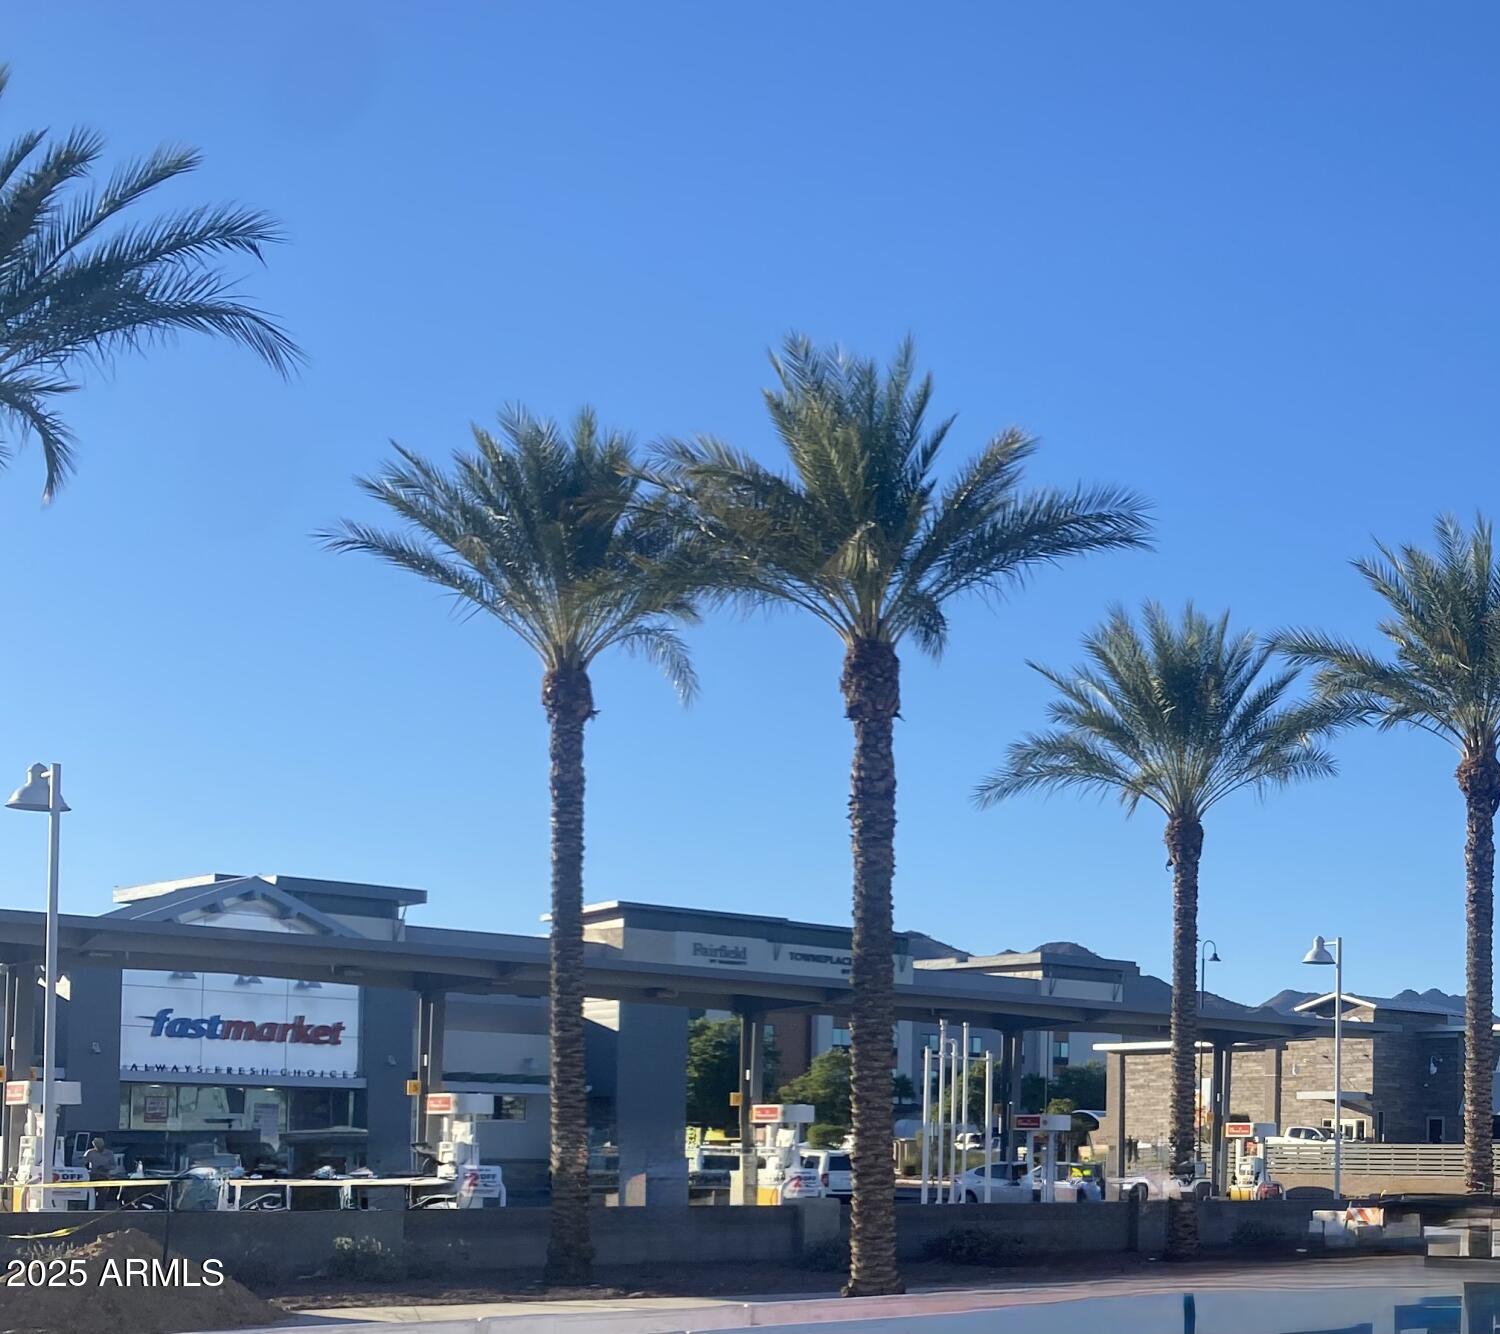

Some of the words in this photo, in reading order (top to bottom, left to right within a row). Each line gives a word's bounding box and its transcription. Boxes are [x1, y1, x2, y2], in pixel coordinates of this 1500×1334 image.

[692, 942, 747, 960] Fairfield
[789, 951, 852, 965] TOWNEPLAC
[145, 1008, 345, 1045] fastmarket
[130, 1064, 203, 1074] ALWAYS
[215, 1066, 270, 1076] FRESH
[280, 1068, 359, 1079] CHOICES
